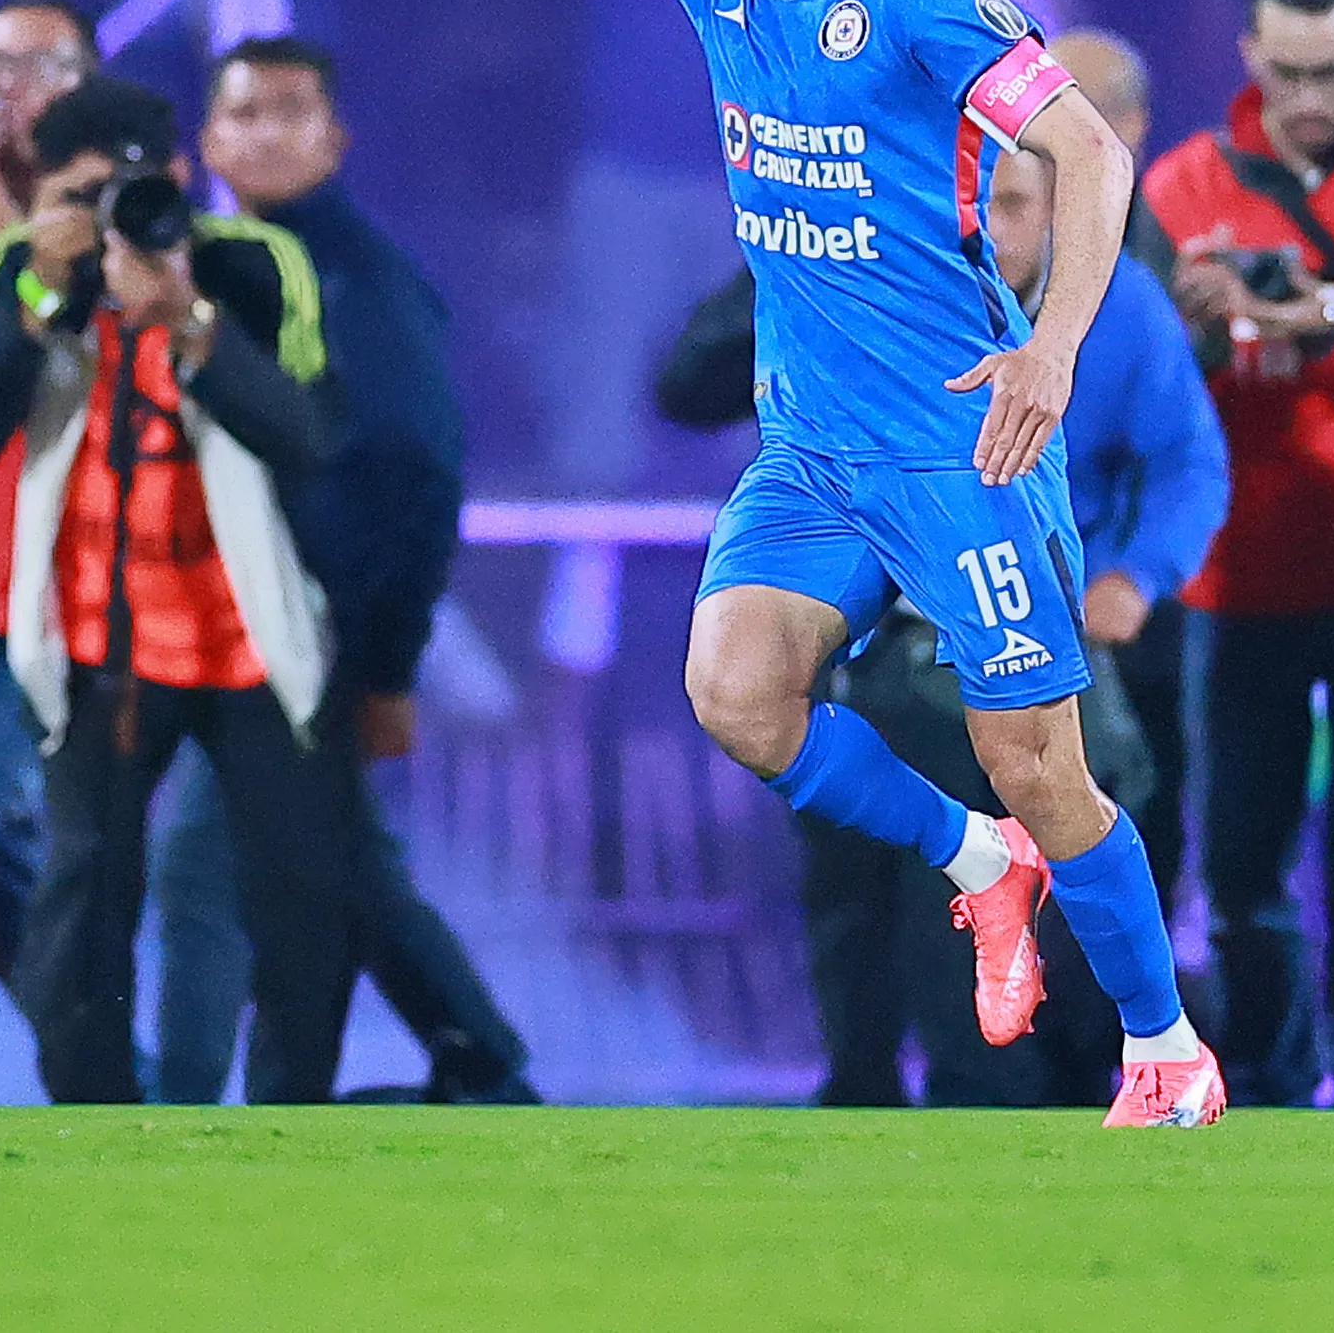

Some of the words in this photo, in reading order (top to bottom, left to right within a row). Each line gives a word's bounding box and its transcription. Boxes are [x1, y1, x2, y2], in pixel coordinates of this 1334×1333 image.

[983, 78, 1009, 108] LIGA
[999, 61, 1046, 107] BBVA
[750, 113, 866, 155] CEMENTO
[753, 148, 804, 187] CRUZ
[805, 160, 873, 190] AZUL
[957, 539, 1032, 629] 15
[982, 650, 1054, 678] PIRMA
